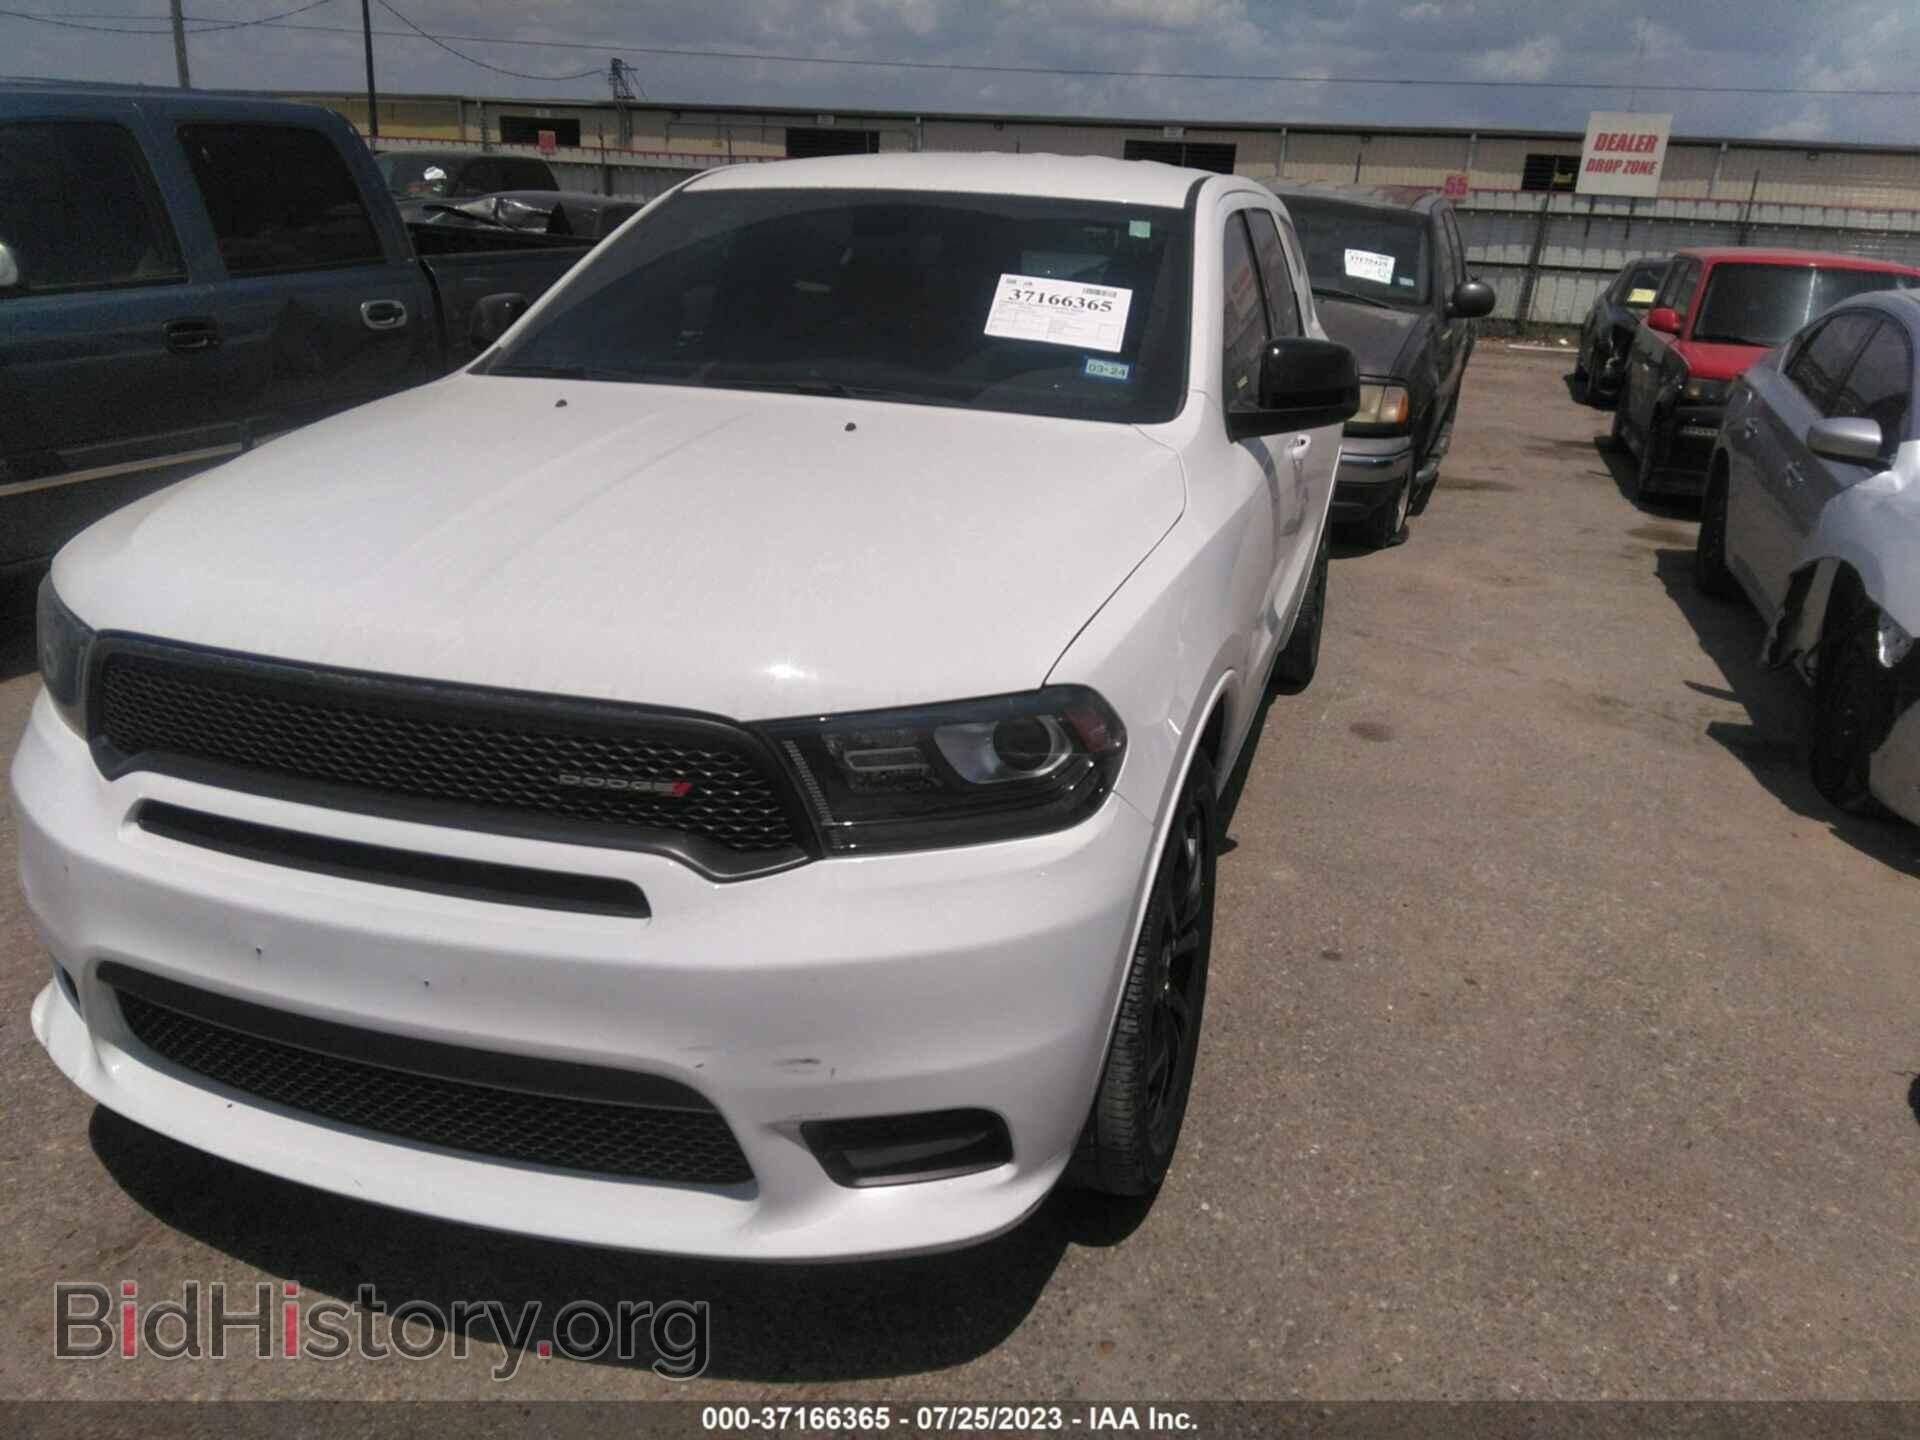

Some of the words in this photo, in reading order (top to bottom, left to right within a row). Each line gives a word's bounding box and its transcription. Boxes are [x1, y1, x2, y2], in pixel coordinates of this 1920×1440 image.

[1593, 132, 1659, 154] DEALER
[1585, 158, 1622, 175] DROP
[1622, 160, 1658, 176] ZONE
[1007, 288, 1113, 313] 37166365
